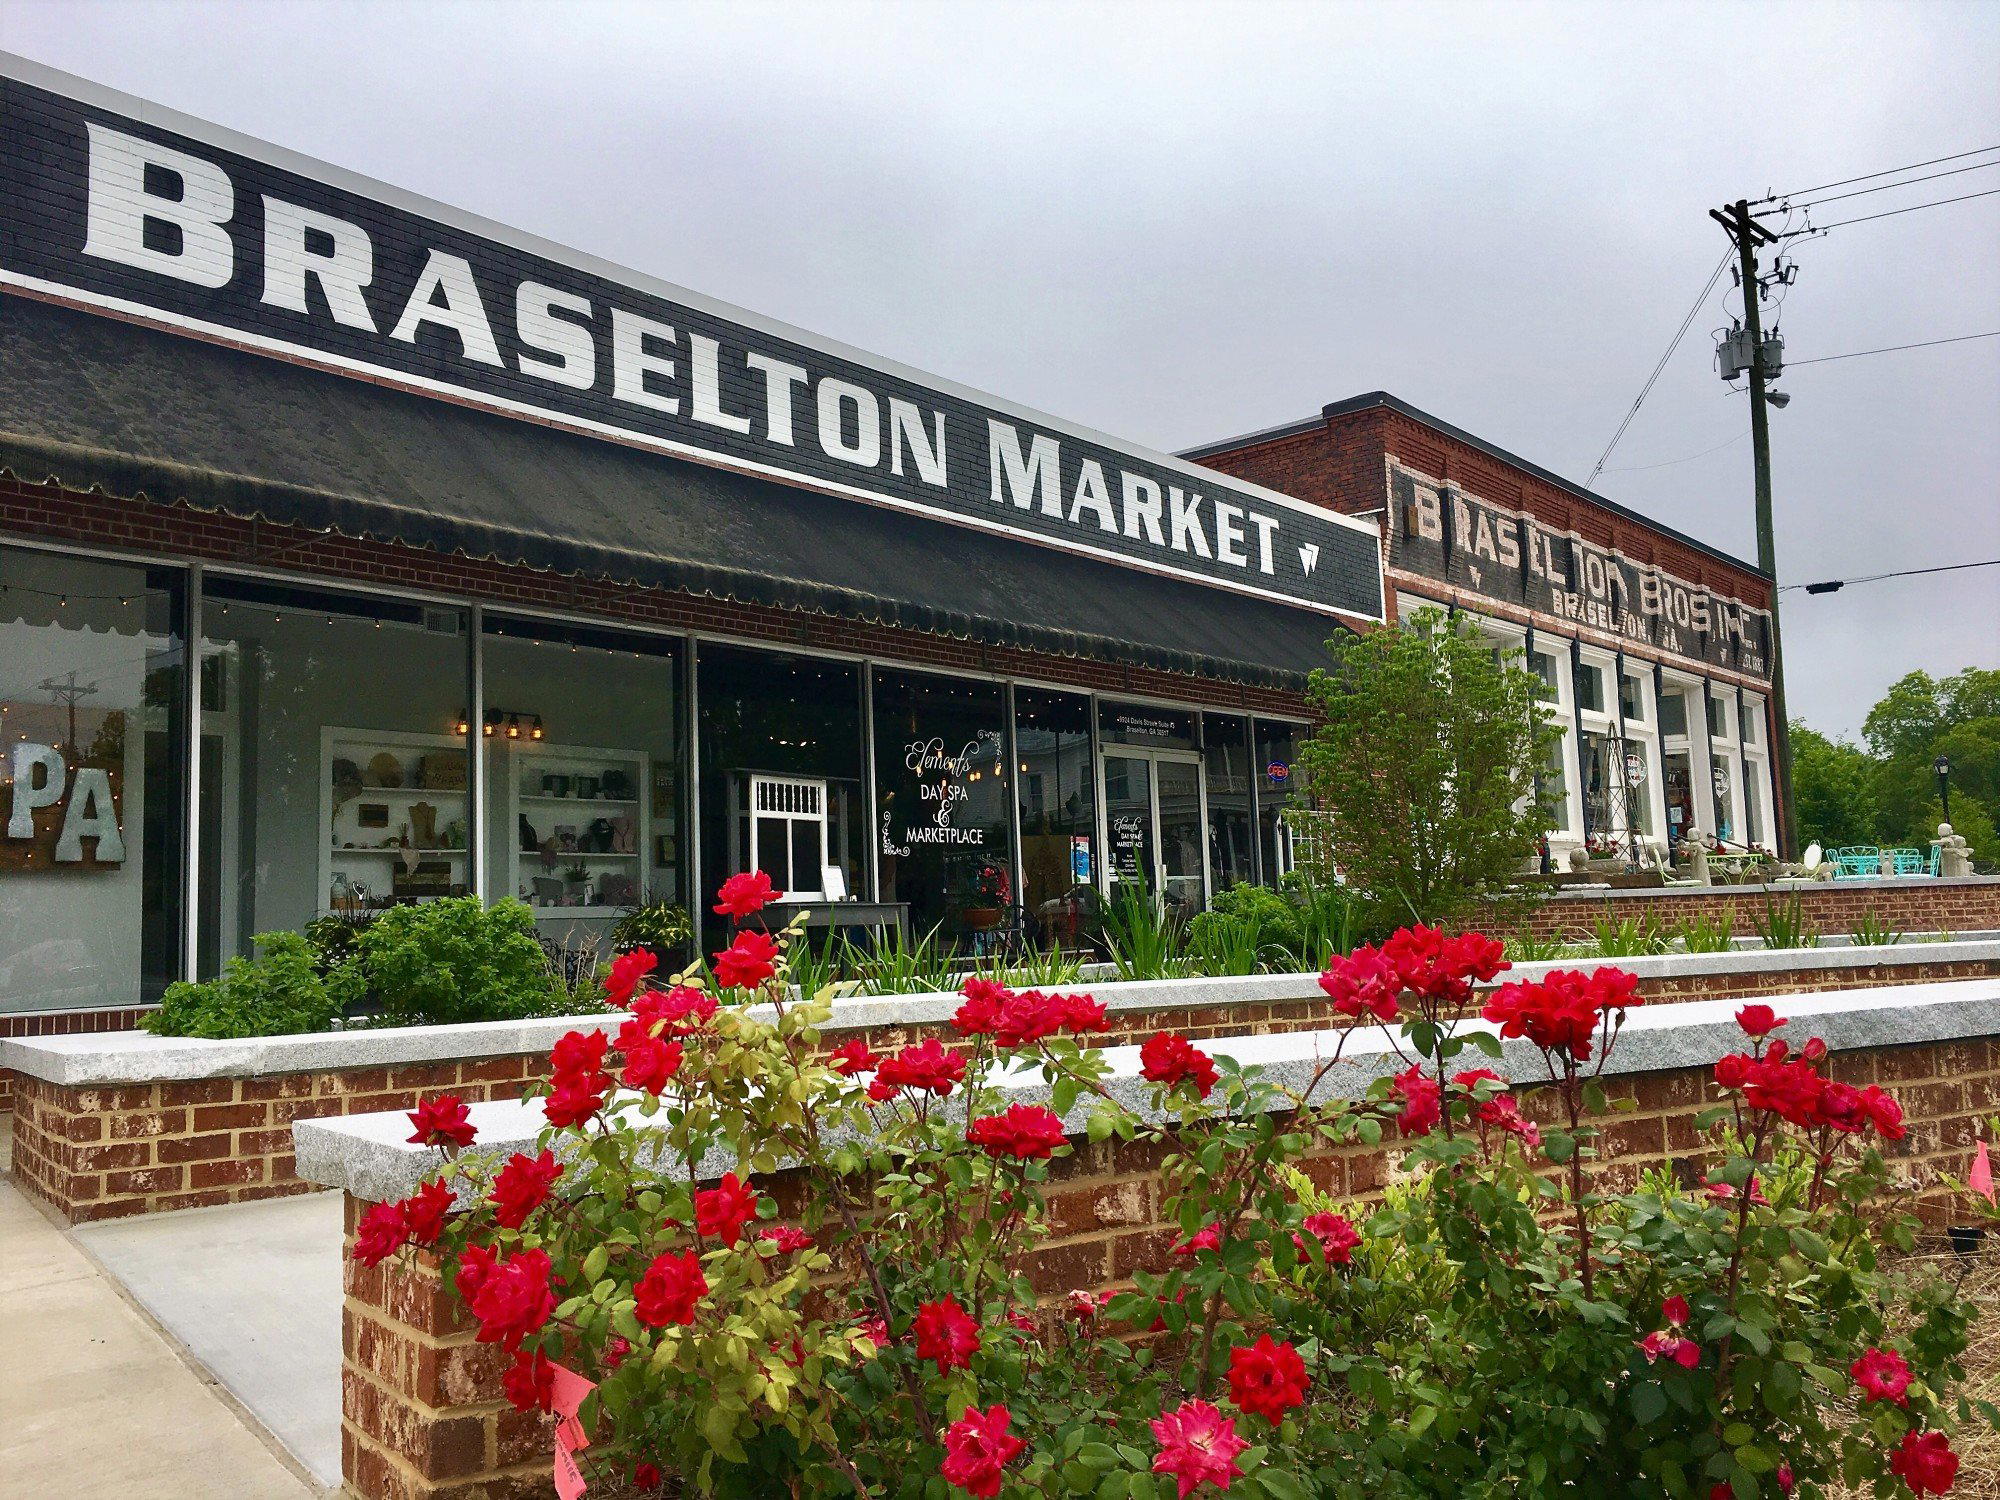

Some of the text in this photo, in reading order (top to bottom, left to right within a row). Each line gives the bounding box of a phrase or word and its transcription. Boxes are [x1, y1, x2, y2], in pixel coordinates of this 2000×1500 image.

[81, 120, 1280, 576] BRASELTON MARKET
[905, 737, 980, 777] Elements
[1267, 764, 1289, 778] OPEN
[920, 784, 969, 801] DAY SPA
[932, 800, 953, 827] &
[905, 827, 984, 845] MARKETPLACE
